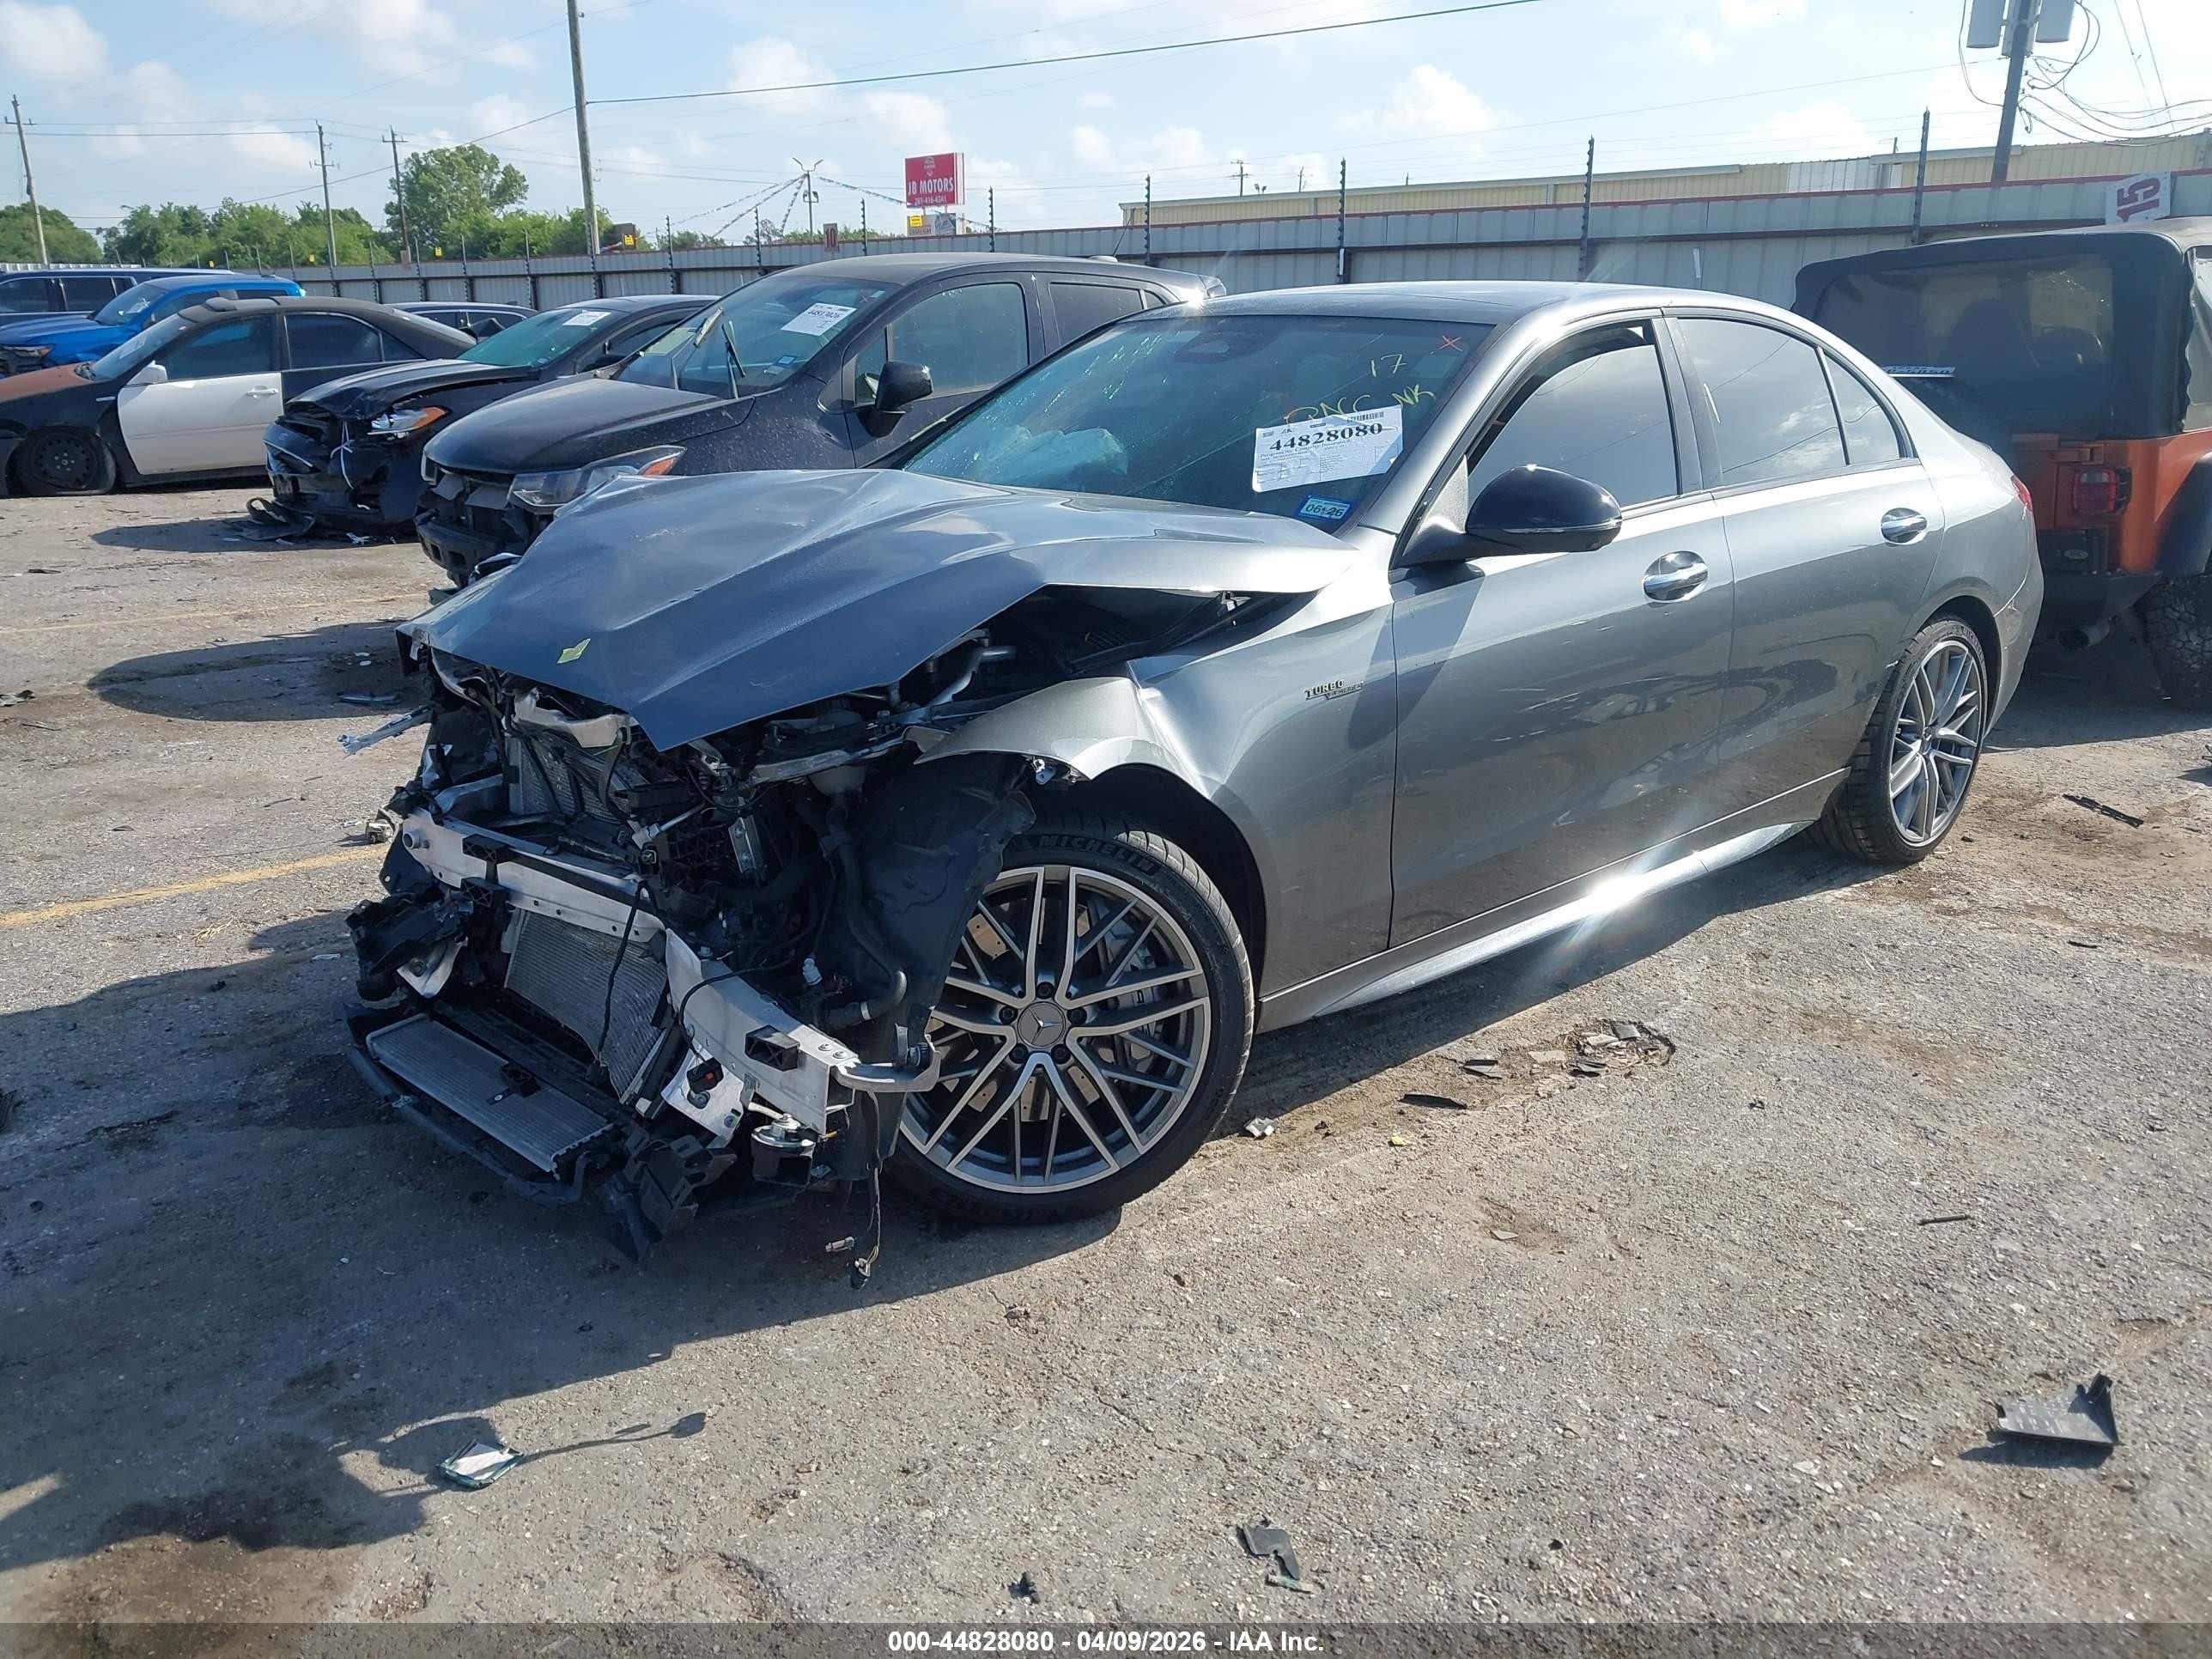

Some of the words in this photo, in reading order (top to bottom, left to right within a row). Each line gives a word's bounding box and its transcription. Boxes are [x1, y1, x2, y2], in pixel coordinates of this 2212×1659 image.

[908, 181, 917, 195] JB
[920, 177, 954, 194] MOTORS
[2116, 177, 2160, 223] 15
[1370, 354, 1407, 378] 17
[1269, 422, 1383, 451] 44828080
[1305, 503, 1322, 514] 06
[1326, 507, 1345, 516] 26
[1304, 679, 1345, 697] TURBO
[1039, 835, 1159, 876] MICHELIN
